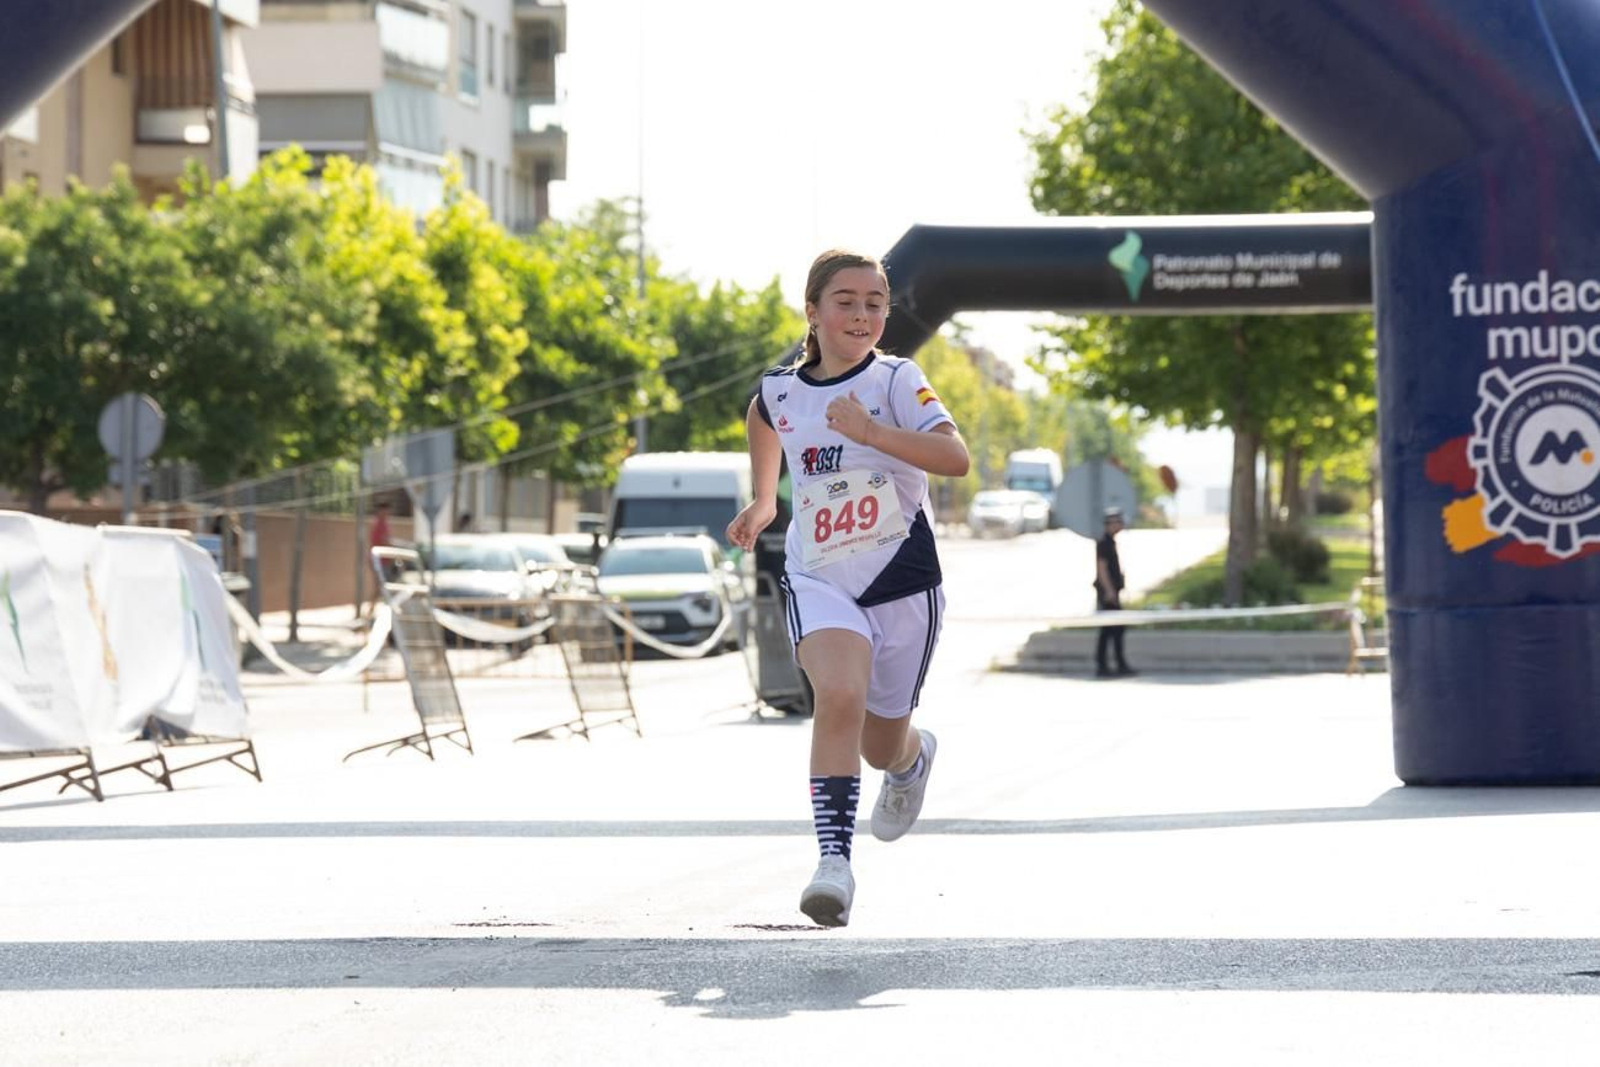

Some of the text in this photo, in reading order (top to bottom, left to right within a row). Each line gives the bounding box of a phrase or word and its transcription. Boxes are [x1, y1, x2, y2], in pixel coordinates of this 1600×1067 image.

[1153, 251, 1341, 271] Patronato Municipal de
[1153, 272, 1229, 291] Deportes
[1231, 272, 1255, 288] de
[1449, 269, 1600, 317] fundac
[814, 495, 879, 544] 849
